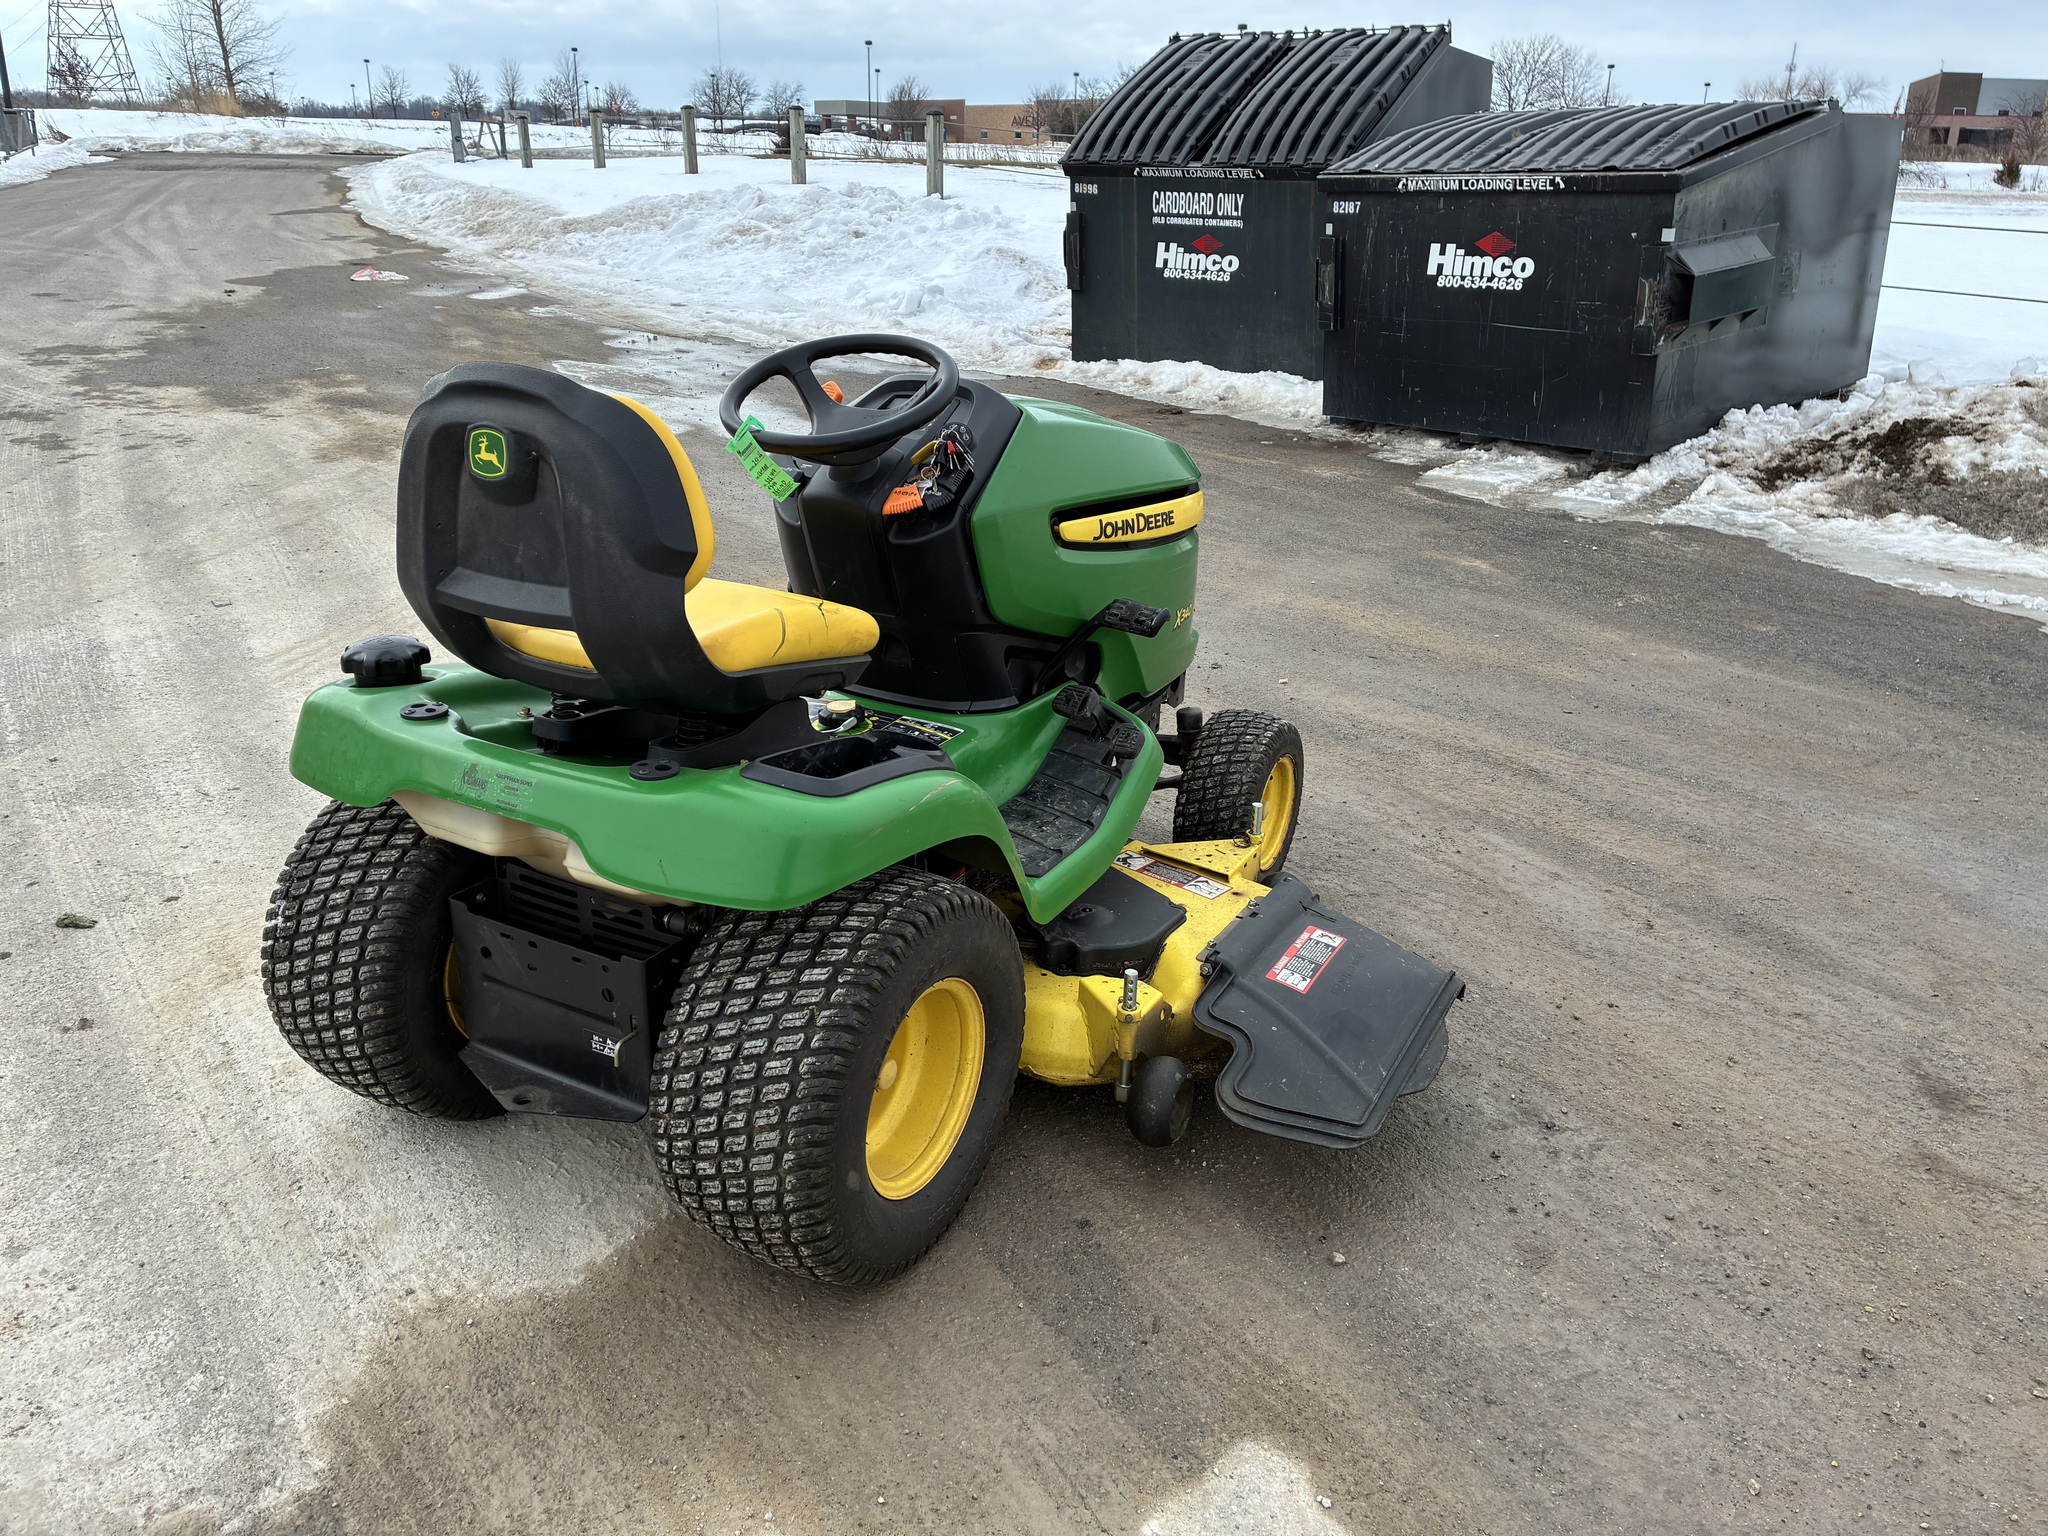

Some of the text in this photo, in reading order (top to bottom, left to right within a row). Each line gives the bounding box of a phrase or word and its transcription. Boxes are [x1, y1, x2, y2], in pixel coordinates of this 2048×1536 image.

[1141, 168, 1257, 180] MAXIMUM LOADING LEVEL
[1074, 182, 1098, 194] 81996
[1461, 179, 1512, 191] LOADING
[1516, 179, 1554, 191] LEVEL
[1152, 190, 1245, 217] CARDBOARD ONLY
[1333, 201, 1361, 214] 82187
[1152, 216, 1244, 229] (OLD CORRUGATED CONTAINERS)
[1155, 241, 1240, 272] Himco
[1426, 243, 1536, 279] Himco
[1163, 267, 1231, 282] 800-634-4626
[1436, 275, 1524, 291] 800-634-4626
[1093, 510, 1175, 541] JOHN DEERE
